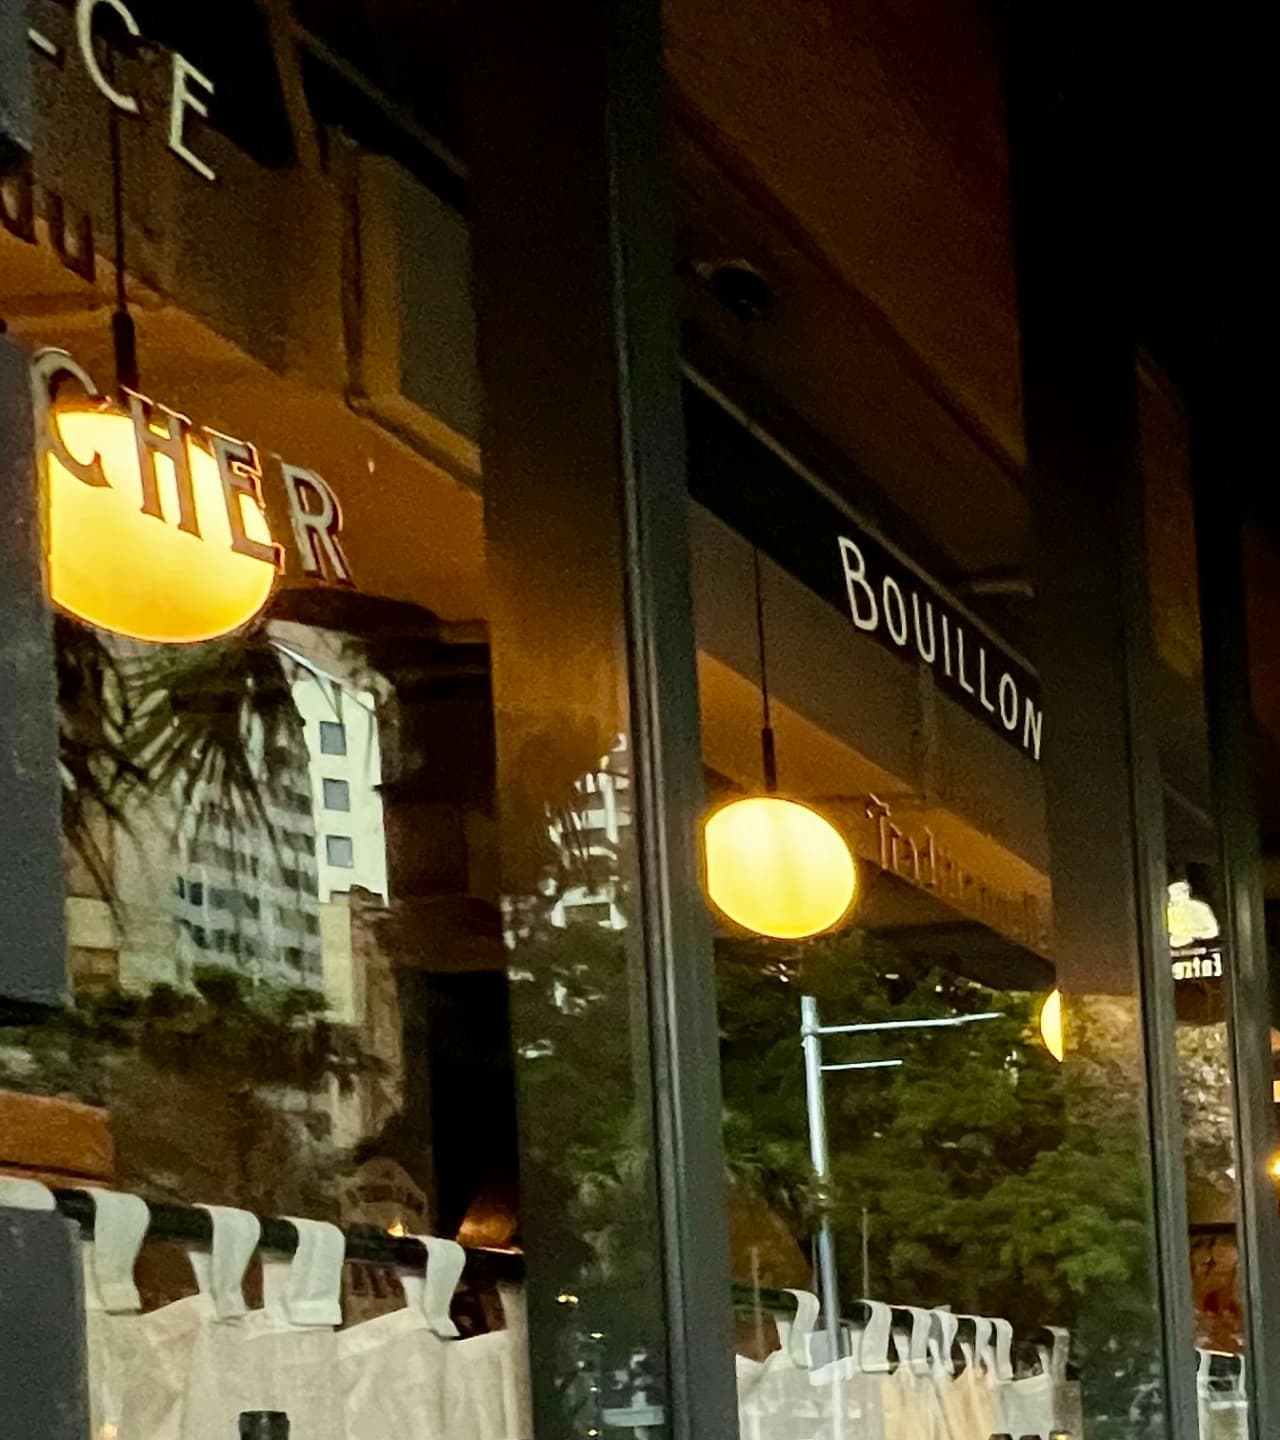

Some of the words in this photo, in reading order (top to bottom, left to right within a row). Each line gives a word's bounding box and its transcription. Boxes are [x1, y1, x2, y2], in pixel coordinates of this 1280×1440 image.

[28, 0, 214, 180] CE
[30, 347, 356, 588] CHER
[838, 535, 1042, 761] BOUILLON
